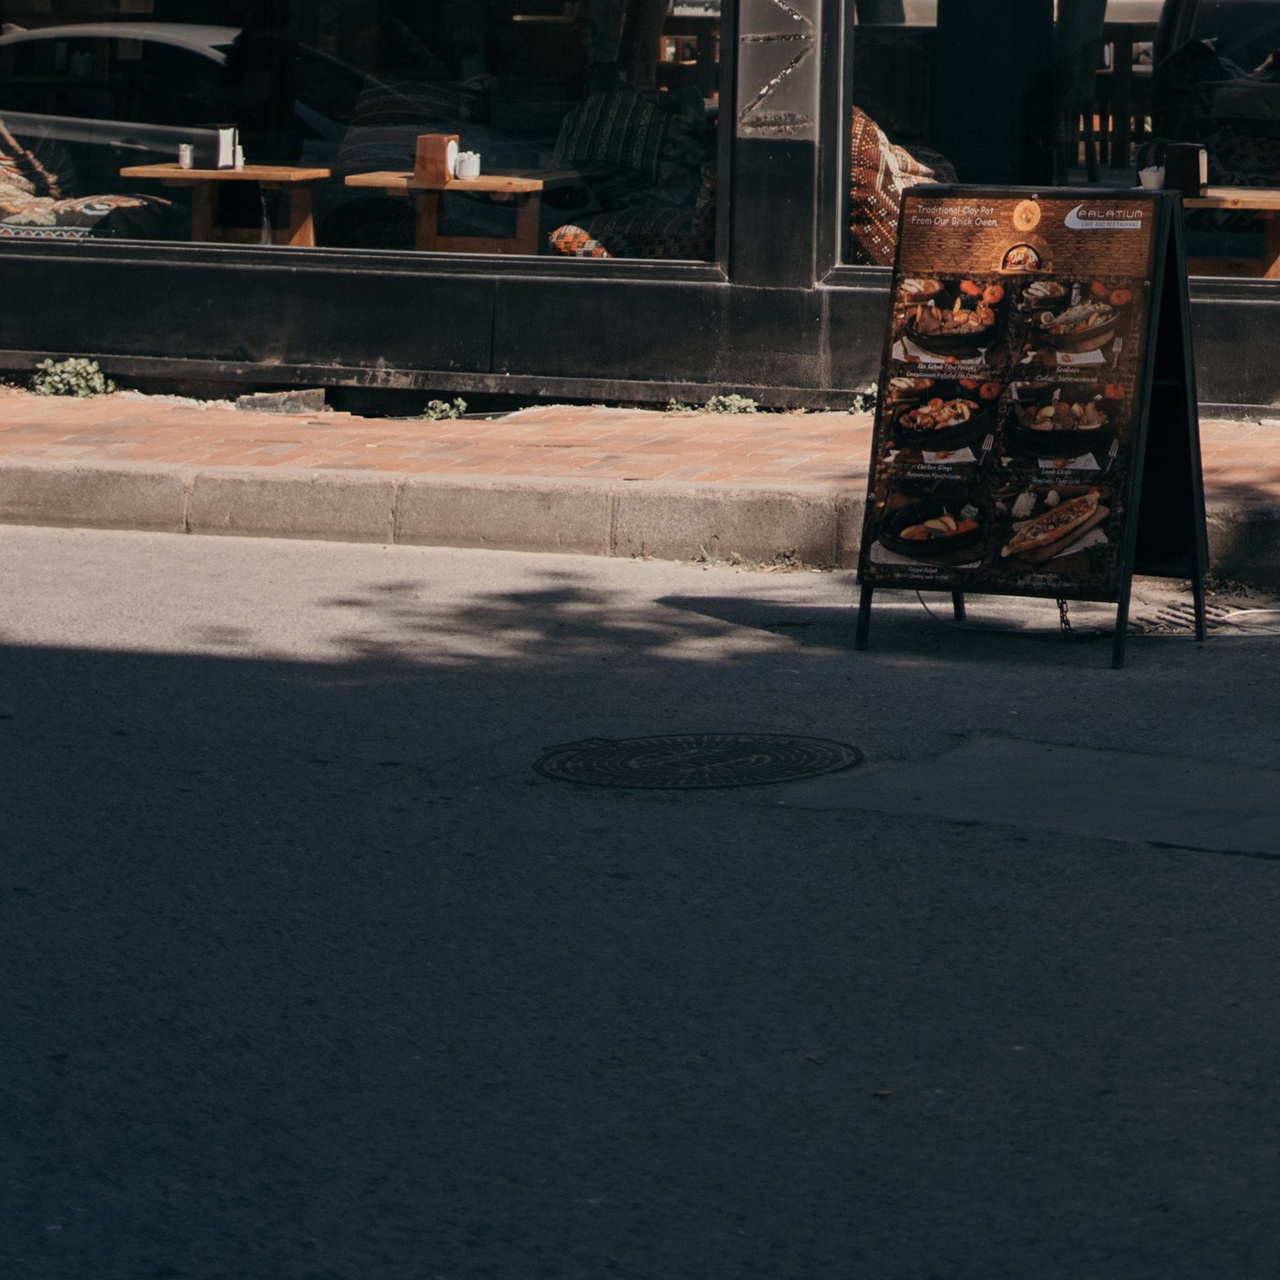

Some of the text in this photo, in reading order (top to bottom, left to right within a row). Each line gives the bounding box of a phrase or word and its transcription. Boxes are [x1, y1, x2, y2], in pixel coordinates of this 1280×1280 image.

[917, 204, 994, 216] Traditional Clay Pot
[1078, 210, 1143, 218] PALATIUM
[911, 216, 932, 225] From
[934, 216, 950, 225] Our
[951, 216, 972, 226] Brick
